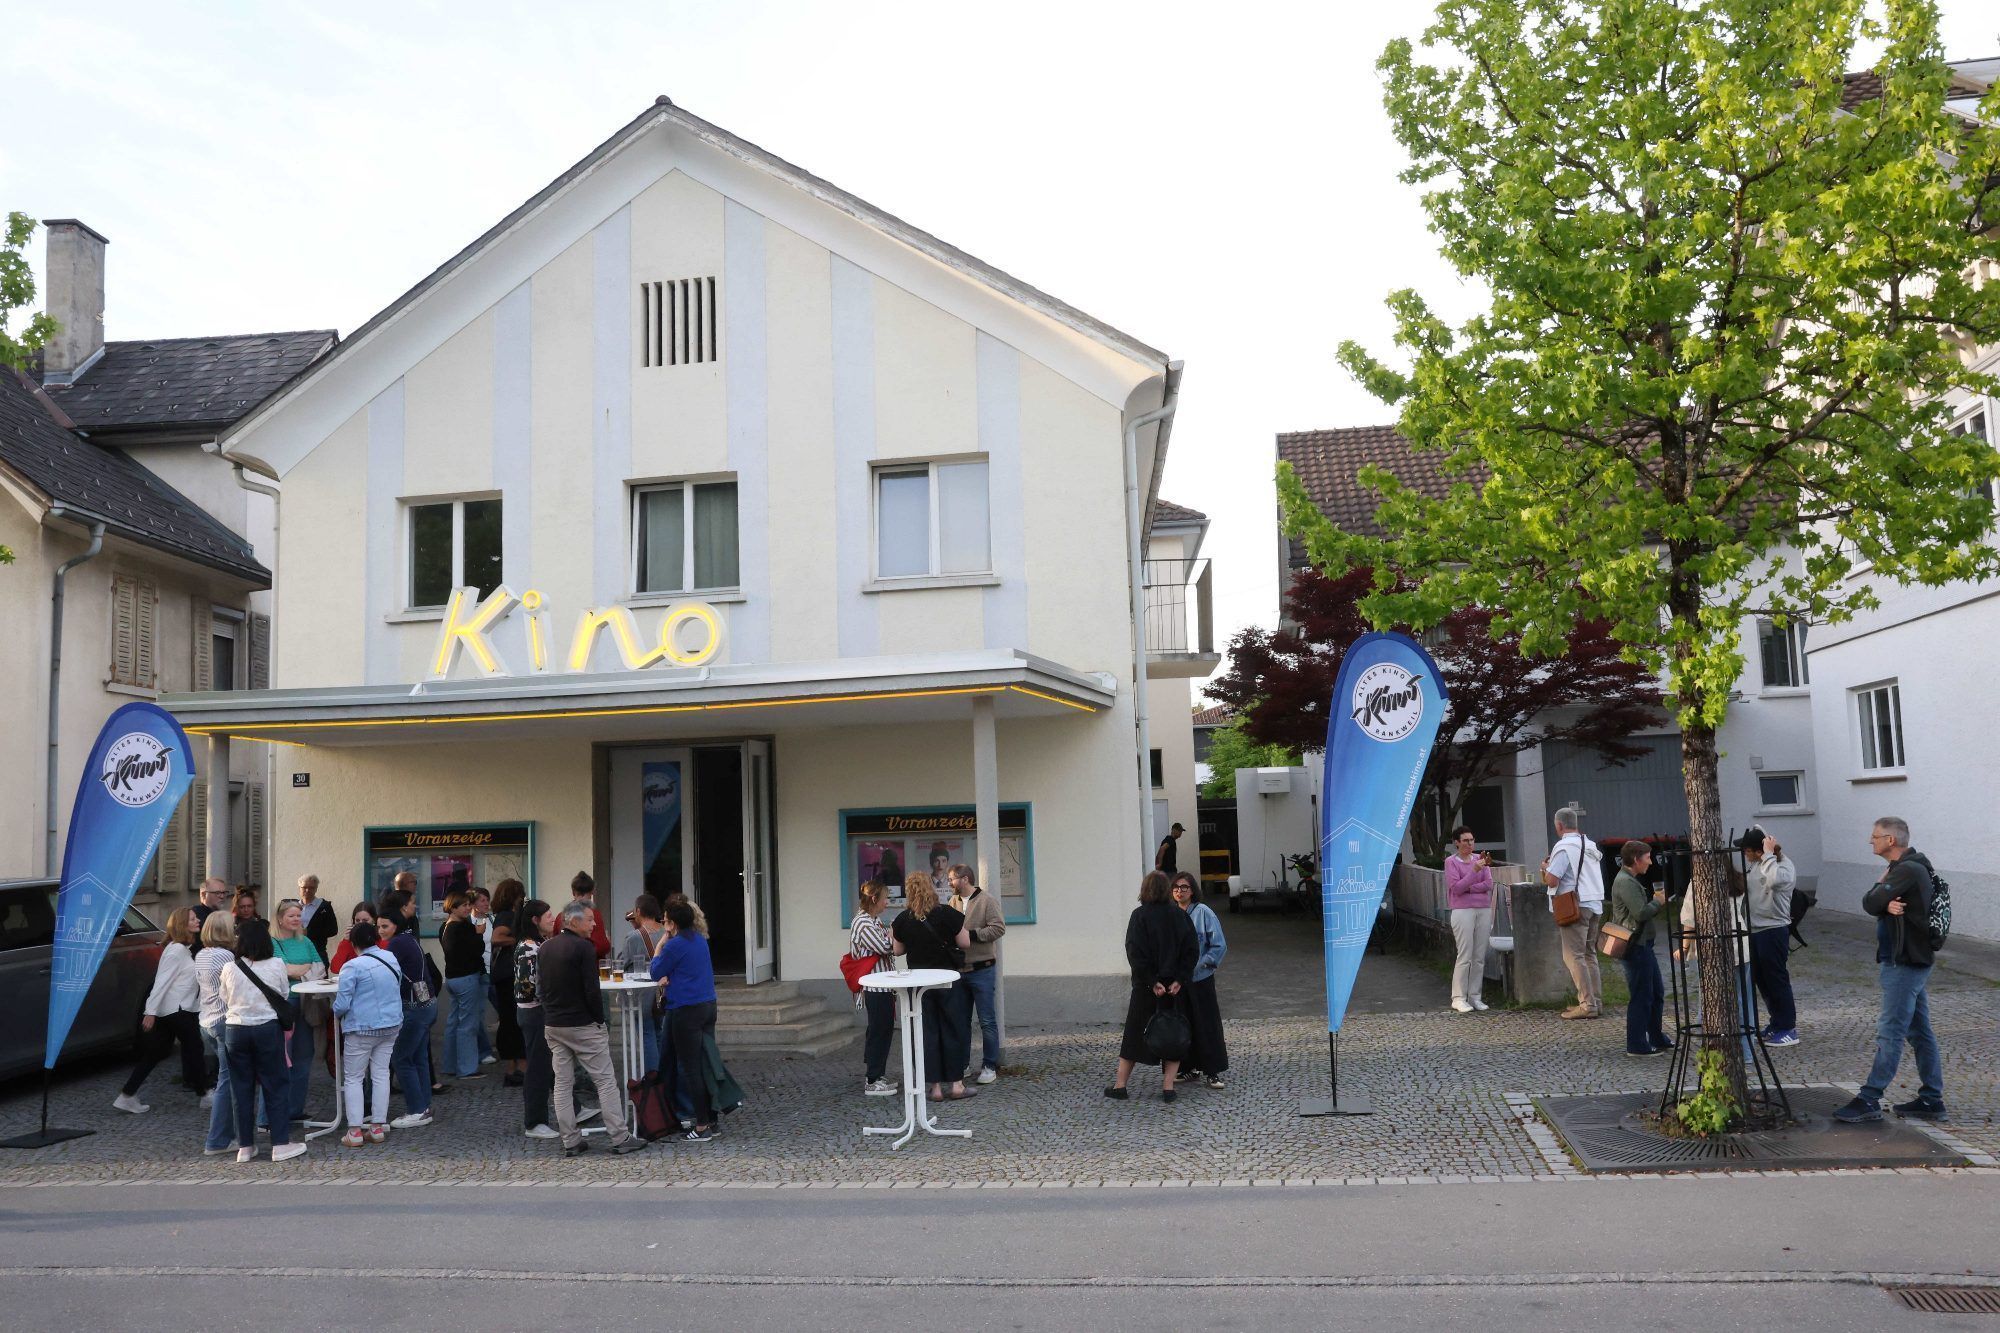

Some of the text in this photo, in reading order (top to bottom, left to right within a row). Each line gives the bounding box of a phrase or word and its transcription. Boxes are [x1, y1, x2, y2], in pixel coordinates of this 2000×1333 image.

[427, 584, 728, 680] Kino
[1358, 668, 1405, 698] ALTES KINO
[1375, 711, 1418, 737] RANKWEIL
[111, 737, 157, 762] ALTES KINO
[296, 774, 306, 783] 30
[1395, 747, 1427, 828] www.alteskino.at
[120, 781, 163, 802] RANKWEIL
[885, 814, 977, 831] Voranzeig
[404, 831, 492, 846] Voranzeige
[128, 817, 166, 889] www.alteskino.at
